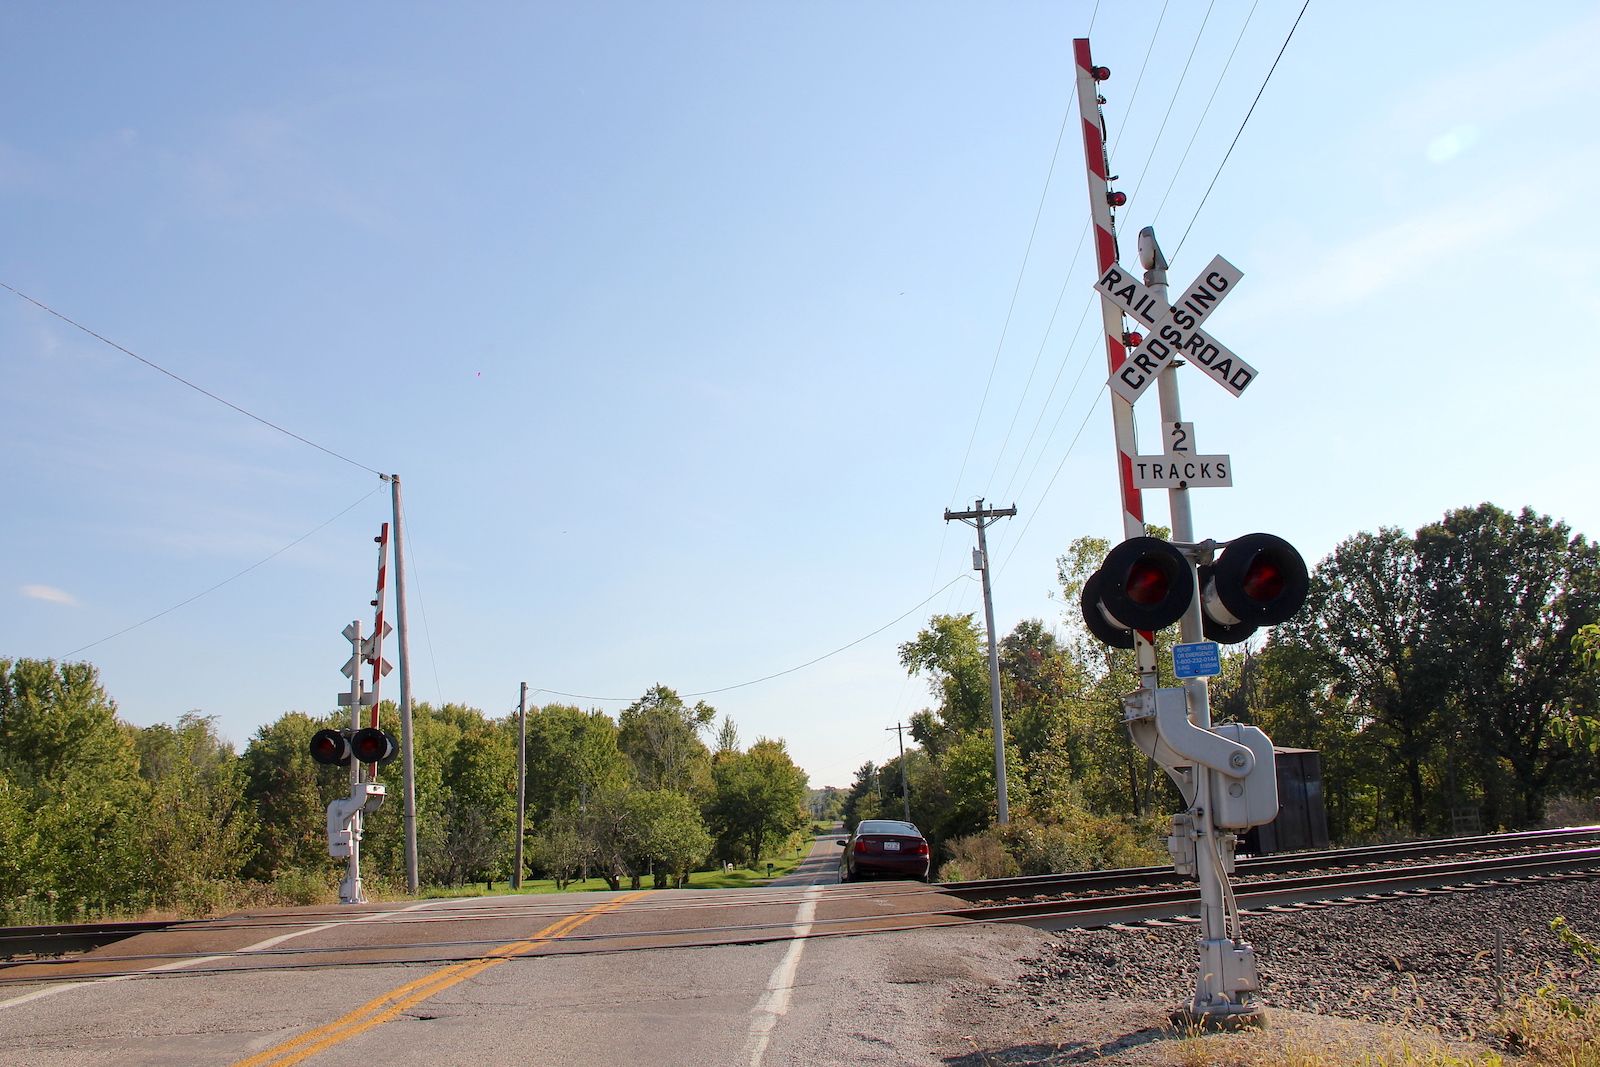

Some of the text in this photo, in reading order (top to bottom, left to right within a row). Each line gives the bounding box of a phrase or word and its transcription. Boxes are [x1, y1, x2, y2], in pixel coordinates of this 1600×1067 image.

[1100, 268, 1252, 391] RAIL ROAD
[1120, 271, 1229, 390] CROSSING
[1171, 429, 1188, 451] 2
[1137, 463, 1227, 480] TRACKS
[1176, 656, 1217, 665] 1-800-232-0144
